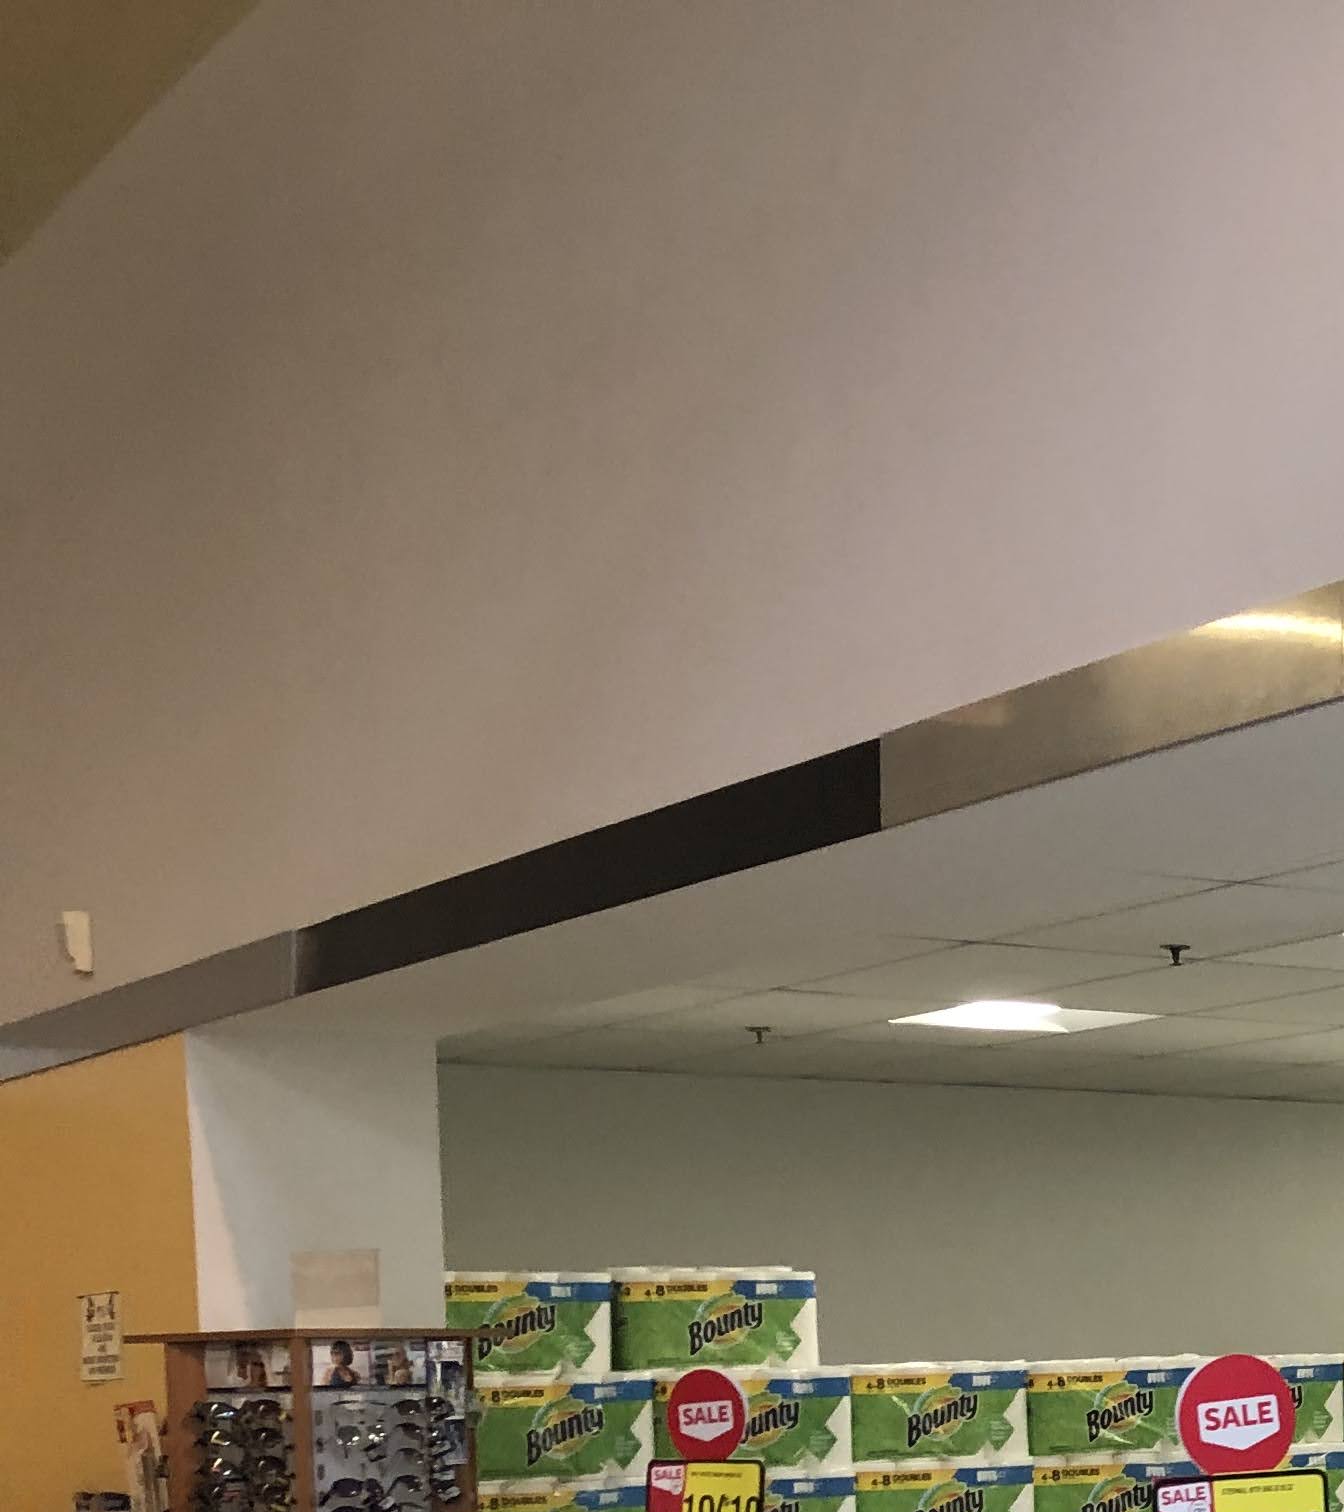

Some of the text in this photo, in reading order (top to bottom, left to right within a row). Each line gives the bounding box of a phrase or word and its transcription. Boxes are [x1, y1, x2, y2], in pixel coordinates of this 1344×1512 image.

[688, 1302, 763, 1357] Bounty
[526, 1406, 604, 1468] Bounty
[683, 1405, 730, 1427] SALE
[906, 1393, 978, 1449] Bounty
[1086, 1389, 1154, 1443] Bounty
[1204, 1401, 1274, 1431] SALE
[655, 1467, 682, 1480] SALE
[1161, 1486, 1208, 1505] SALE
